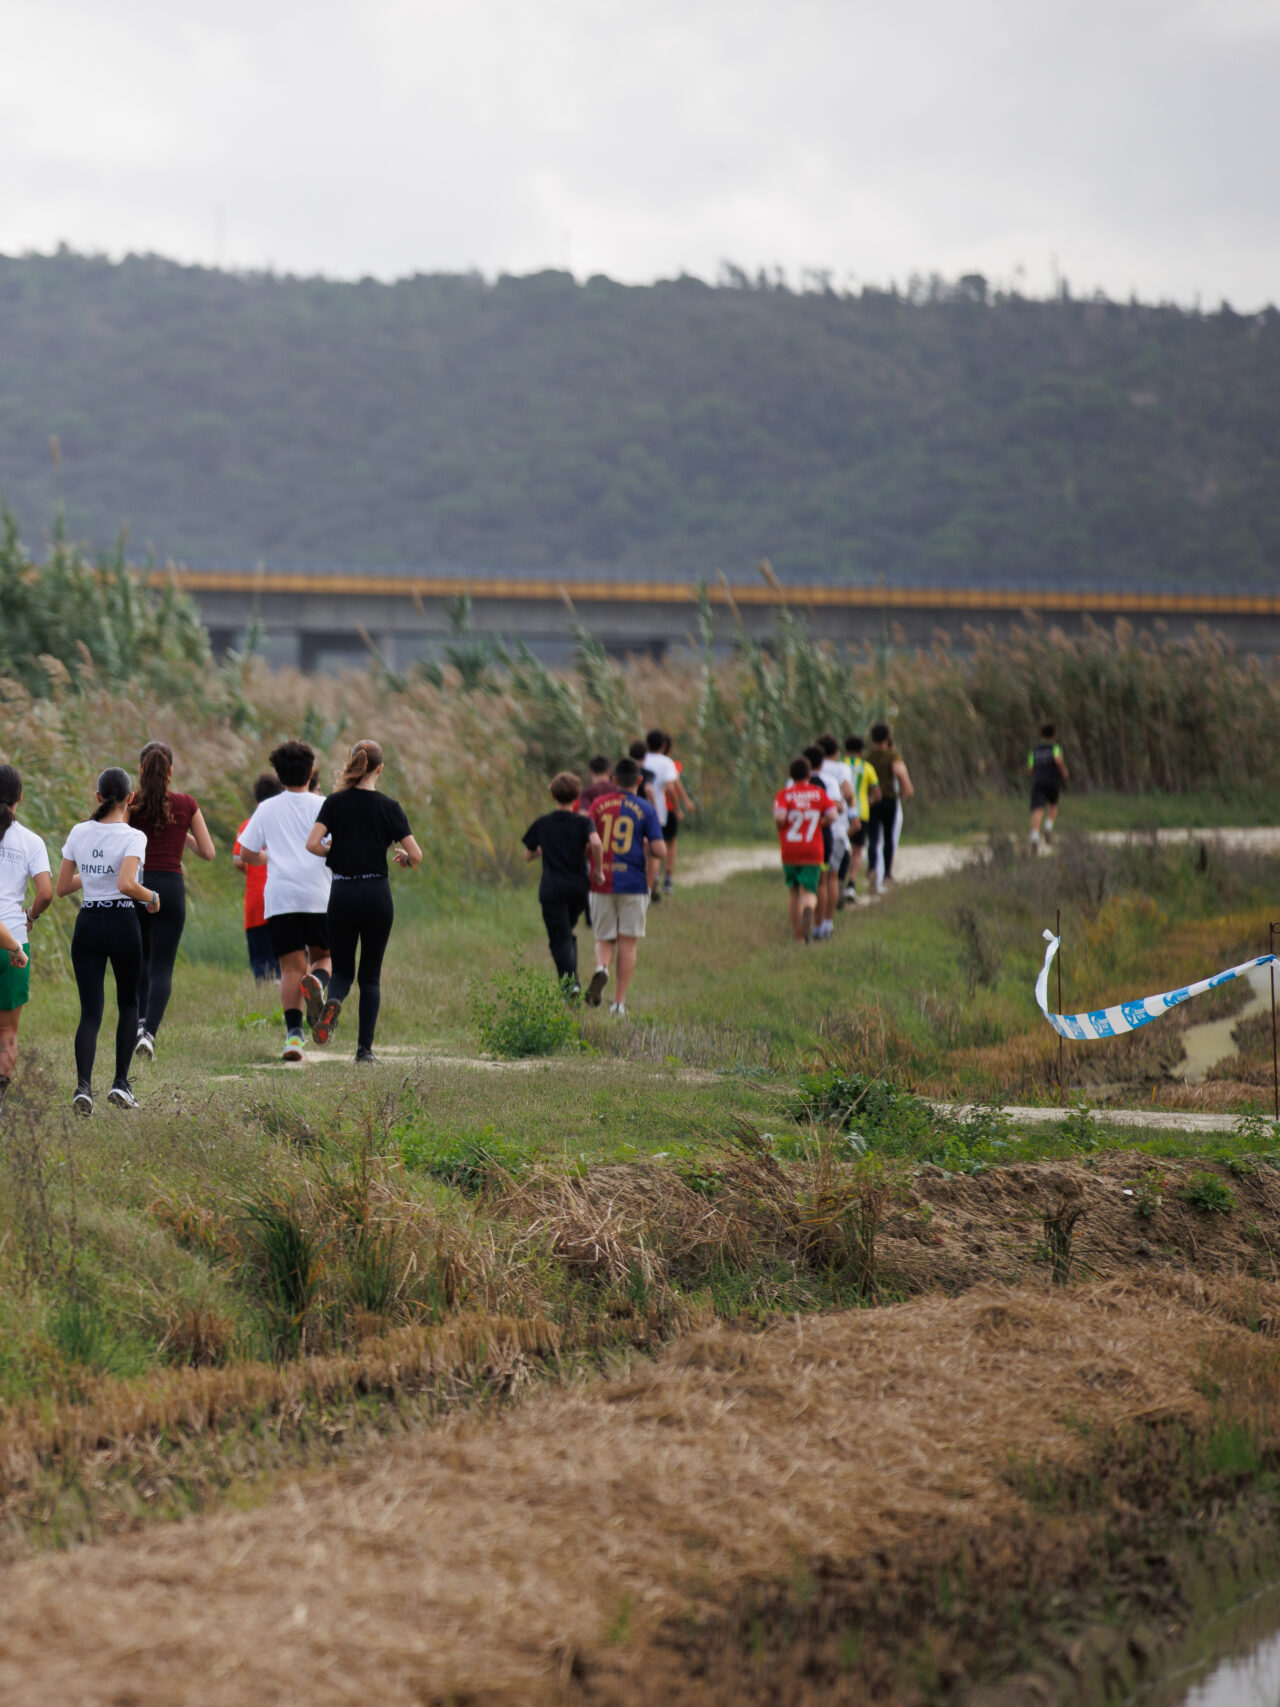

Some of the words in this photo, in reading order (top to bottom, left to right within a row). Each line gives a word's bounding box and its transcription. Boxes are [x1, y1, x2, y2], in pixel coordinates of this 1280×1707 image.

[601, 813, 635, 855] 19
[786, 810, 821, 843] 27
[92, 848, 104, 858] 04
[81, 863, 115, 874] PINELA
